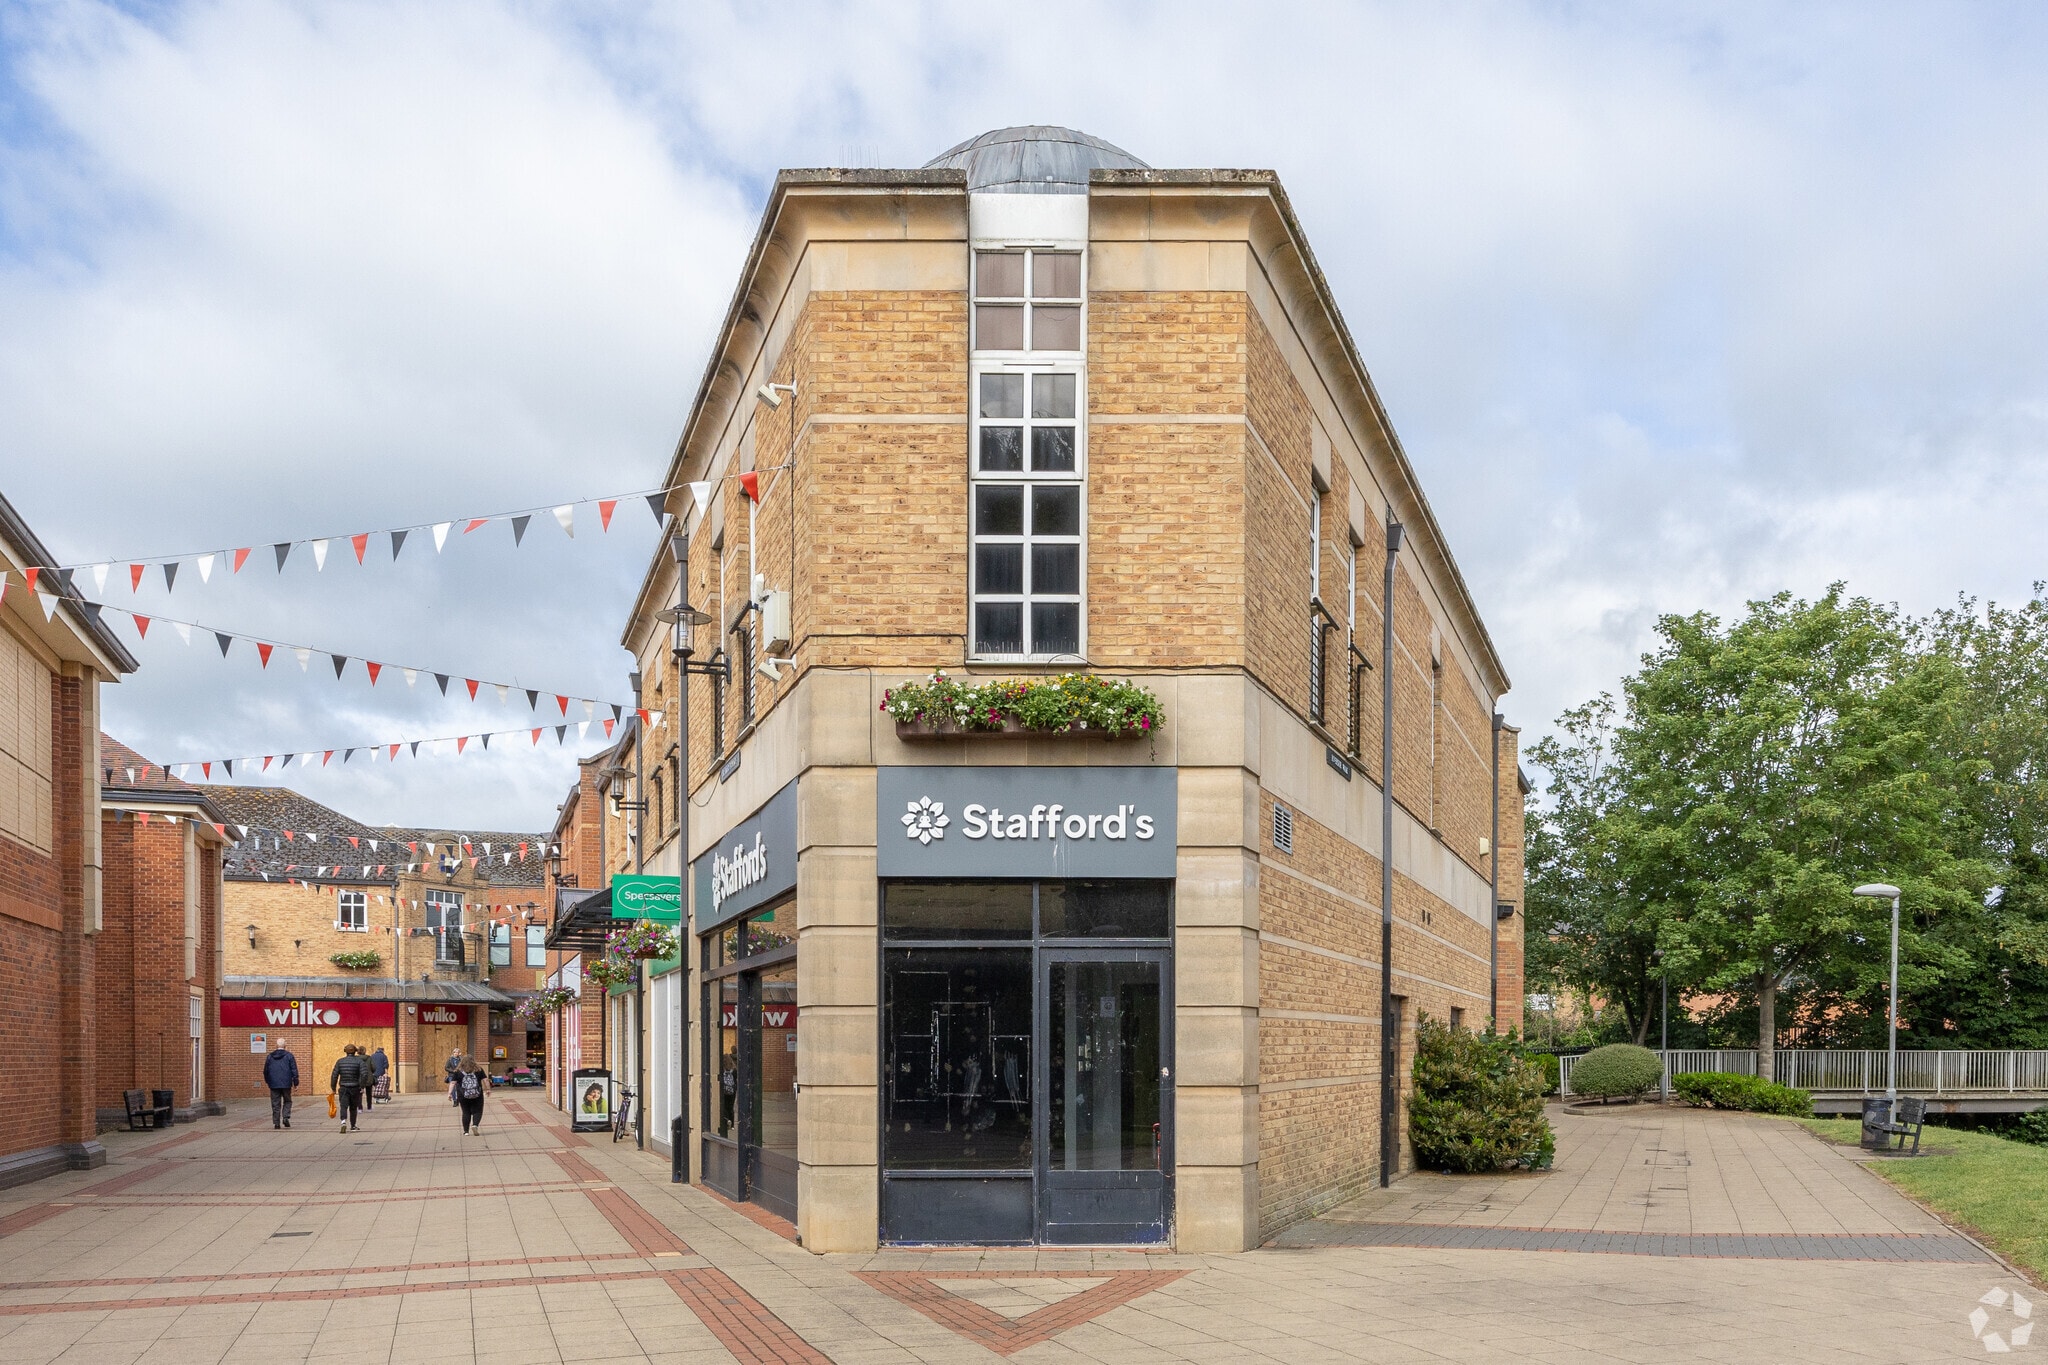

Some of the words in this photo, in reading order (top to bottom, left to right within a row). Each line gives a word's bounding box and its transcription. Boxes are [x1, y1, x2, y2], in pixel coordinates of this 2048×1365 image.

[962, 804, 1155, 839] Stafford's
[720, 831, 767, 900] Stafford's
[624, 891, 681, 901] Specsavers
[264, 1001, 340, 1025] wilko
[423, 1006, 457, 1022] wilko
